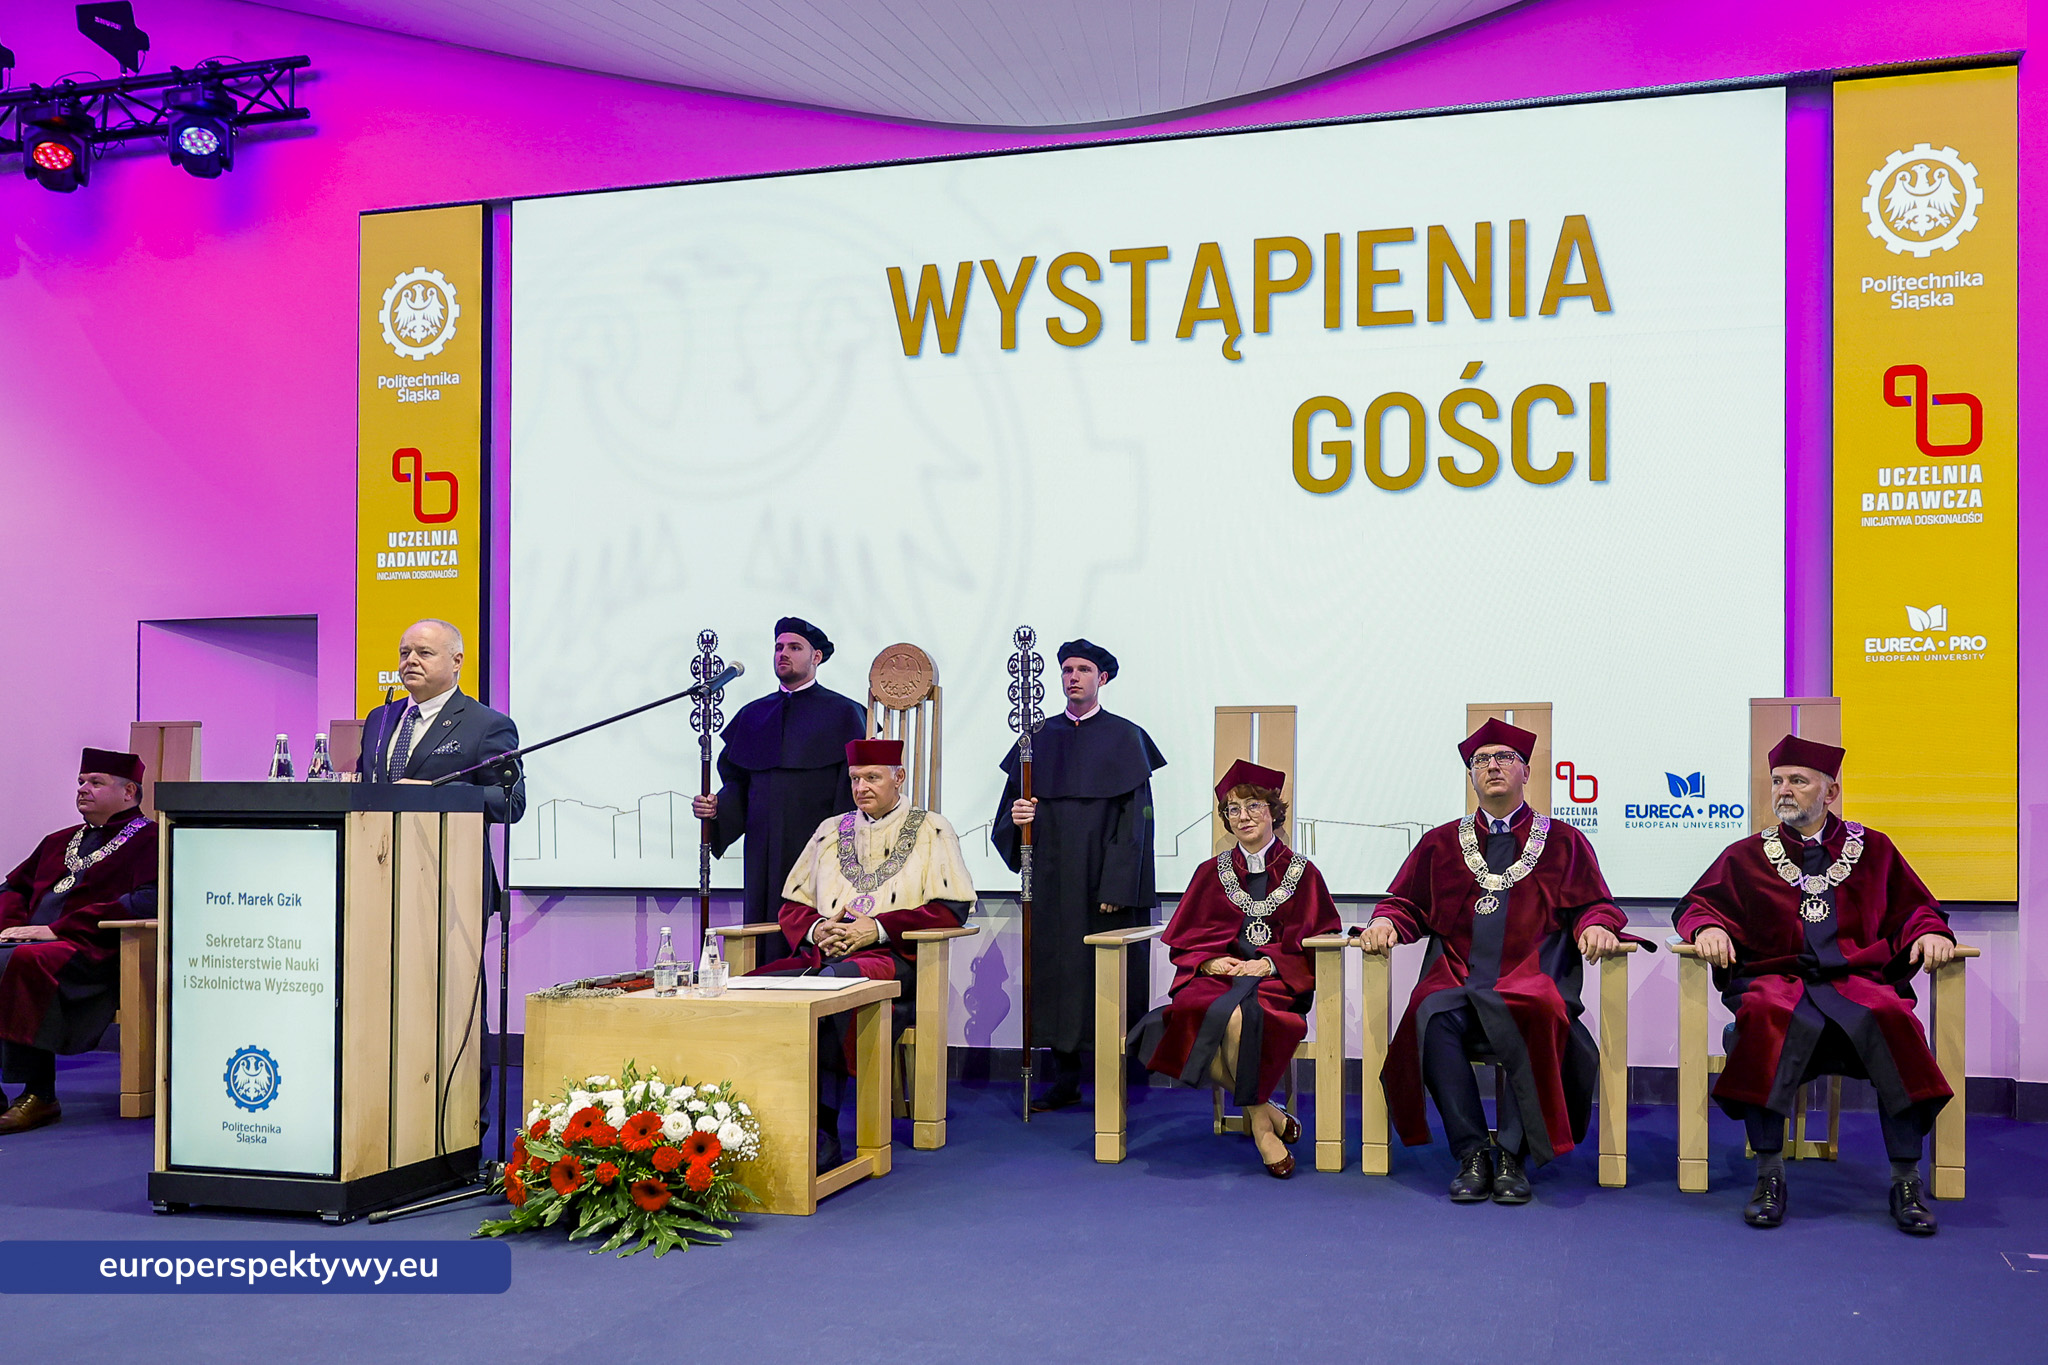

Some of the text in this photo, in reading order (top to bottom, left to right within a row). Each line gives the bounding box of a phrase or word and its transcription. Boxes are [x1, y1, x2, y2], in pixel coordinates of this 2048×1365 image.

[886, 214, 1613, 361] WYSTĄPIENIA
[1861, 270, 1984, 293] Politechnika
[1890, 289, 1954, 310] Śląska
[377, 371, 460, 389] Politechnika
[397, 386, 440, 404] Śląska
[1292, 361, 1608, 494] GOŚCI
[1878, 464, 1983, 487] UCZELNIA
[1861, 488, 1983, 512] BADAWCZA
[1861, 511, 1983, 527] INICJATYWA DOSKONAŁOŚCI
[388, 529, 458, 548] UCZELNIA
[377, 549, 458, 568] BADAWCZA
[376, 568, 458, 580] INICJATYWA DOSKONAŁOŚCI
[1865, 635, 1987, 653] EURECA PRO
[1865, 653, 1985, 662] EUROPEAN UNIVERSITY
[1553, 807, 1598, 816] UCZELNIA
[1625, 804, 1745, 818] EURECA PRO
[1625, 821, 1743, 829] EUROPEAN UNIVERSITY
[206, 891, 302, 907] Prof. Marek Gzik
[206, 934, 302, 949] Sekretarz Stanu
[188, 955, 319, 972] w Ministerstwie Nauki
[183, 975, 324, 997] i Szkolnictwa Wyższego
[222, 1121, 282, 1134] Politechnika
[236, 1132, 267, 1144] Śląska
